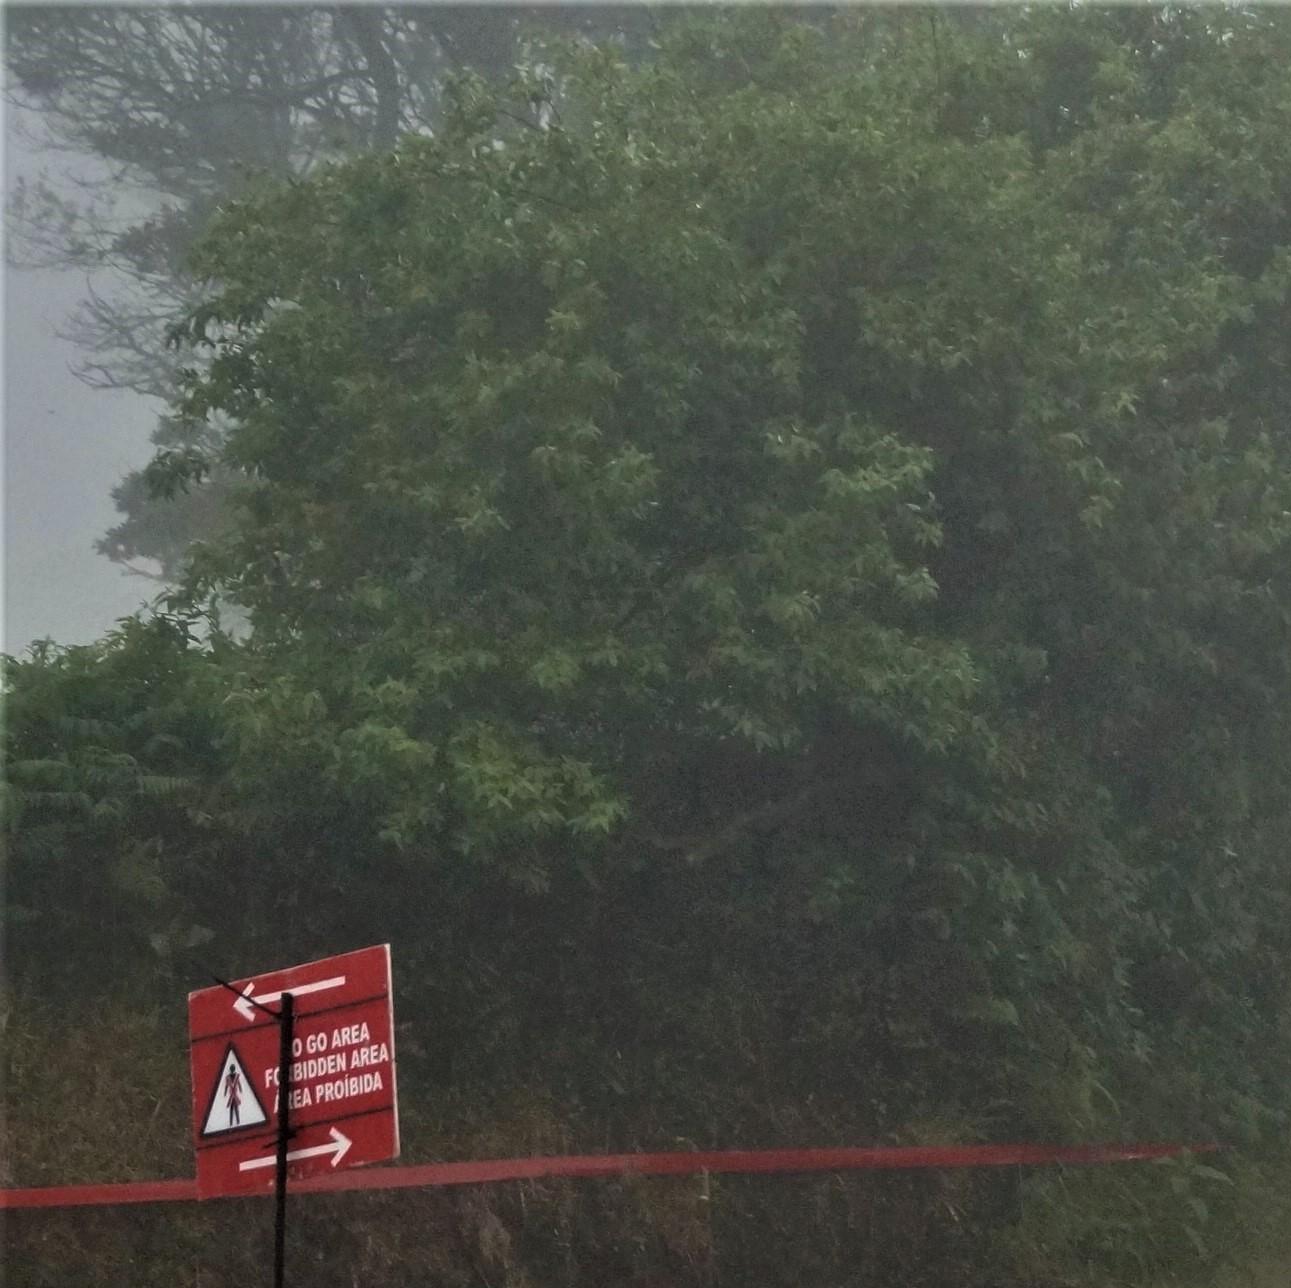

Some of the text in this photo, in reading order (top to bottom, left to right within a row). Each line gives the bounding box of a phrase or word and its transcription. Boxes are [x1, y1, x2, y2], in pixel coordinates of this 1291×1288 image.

[306, 1032, 327, 1054] GO
[332, 1022, 370, 1049] AREA
[350, 1042, 389, 1069] AREA
[315, 1071, 383, 1104] PROÍBIDA
